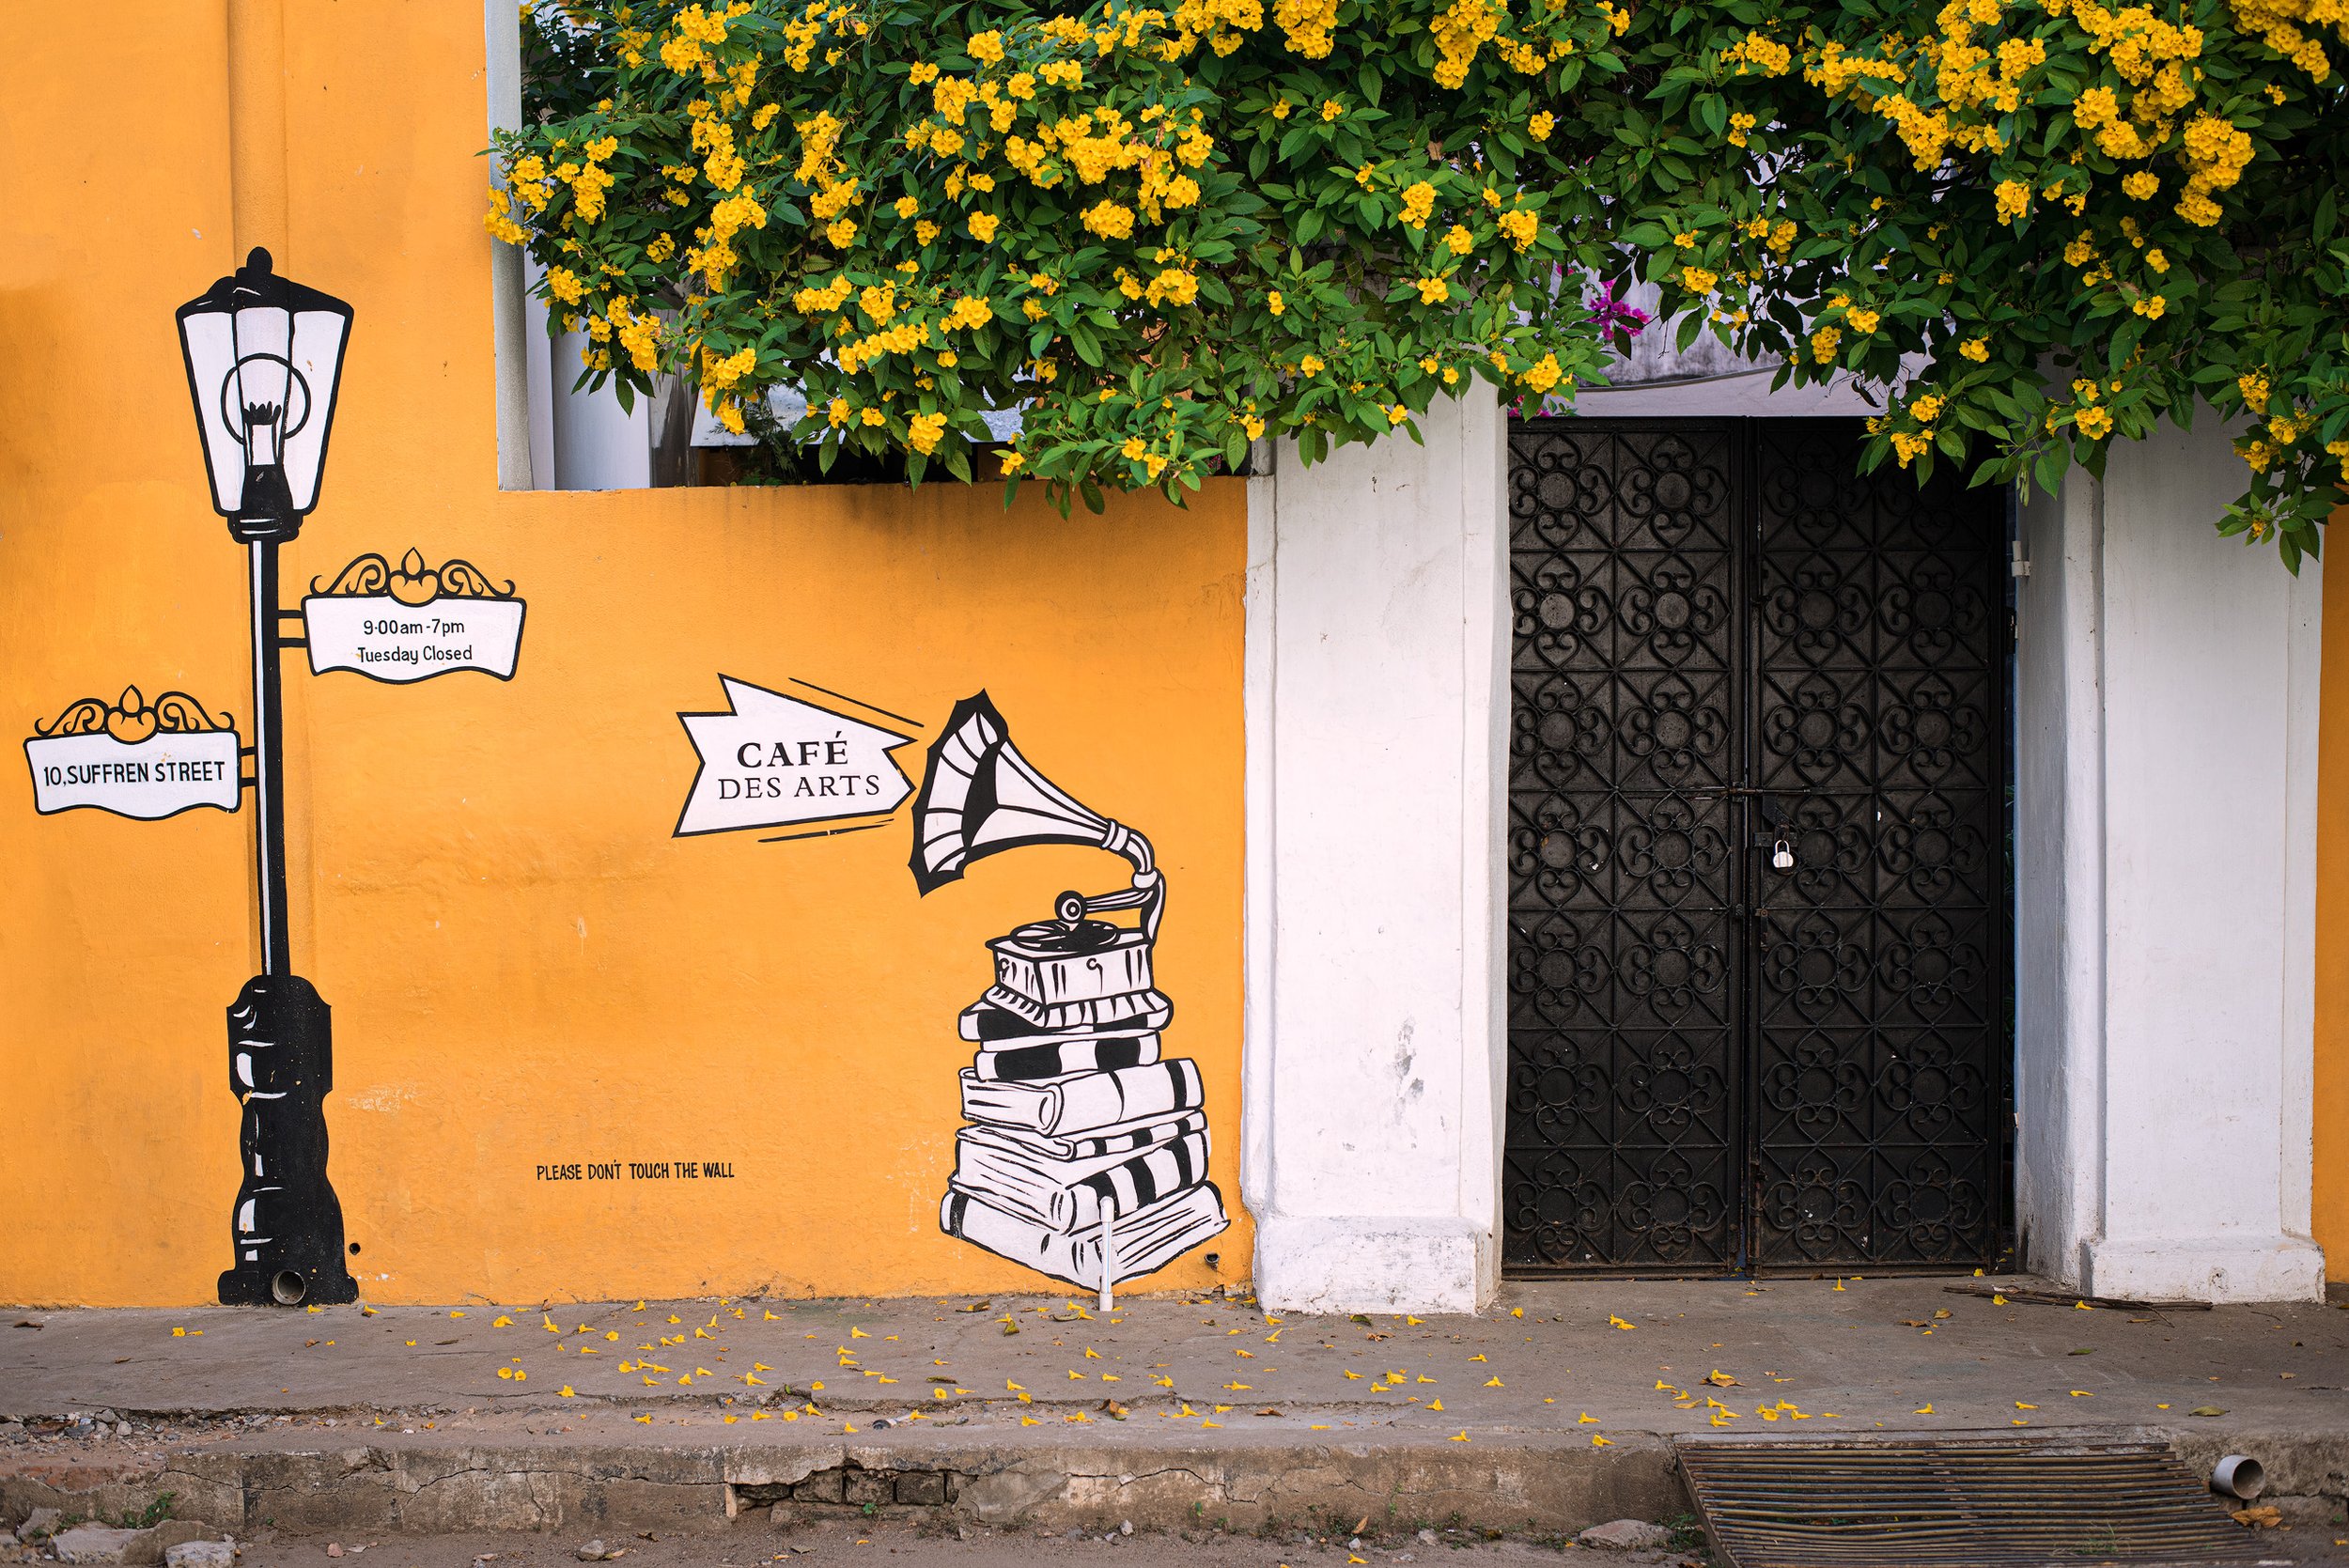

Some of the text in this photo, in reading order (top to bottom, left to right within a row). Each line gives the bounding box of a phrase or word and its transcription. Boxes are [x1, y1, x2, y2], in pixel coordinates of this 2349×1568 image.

[357, 644, 473, 665] Tuesday Closed
[737, 731, 848, 768] CAFÉ
[154, 760, 226, 783] STREET
[718, 774, 879, 800] DES ARTS
[536, 1159, 736, 1181] PLEASE DON'T TOUCH THE WALL
